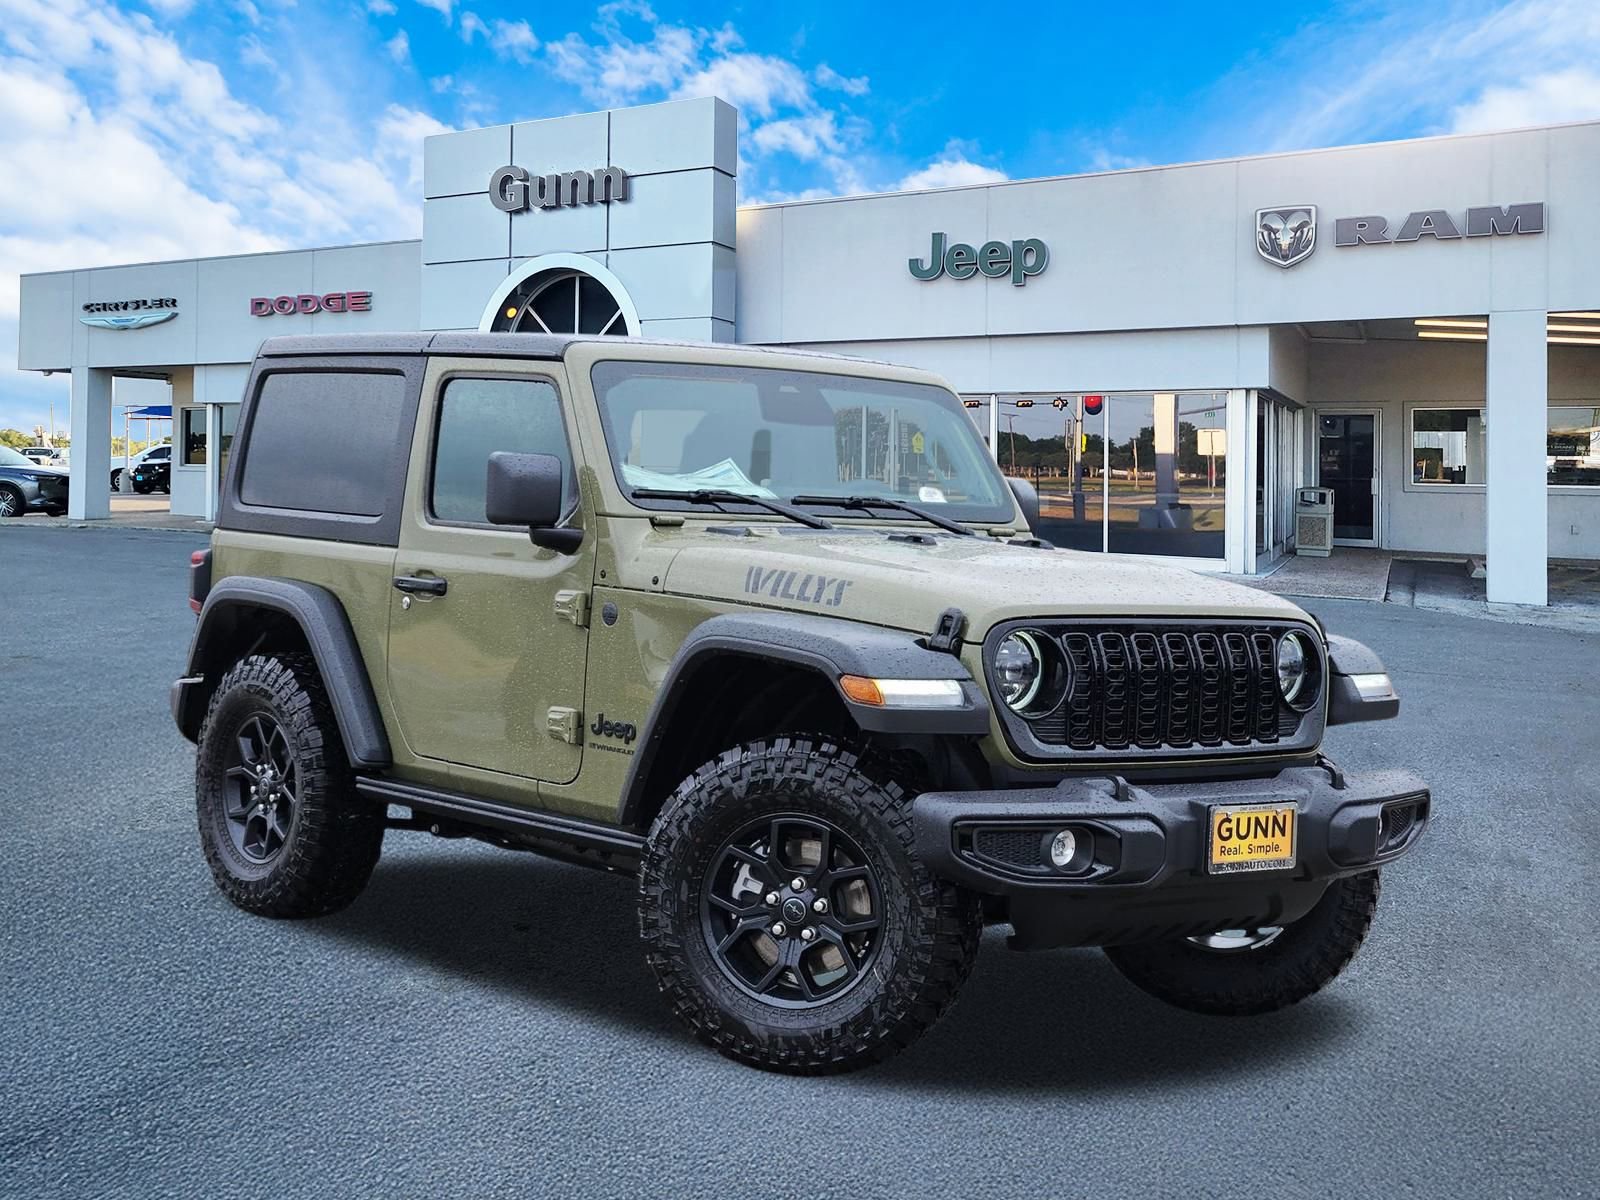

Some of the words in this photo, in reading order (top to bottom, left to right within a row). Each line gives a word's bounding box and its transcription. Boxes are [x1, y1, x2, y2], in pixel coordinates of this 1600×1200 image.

[489, 164, 628, 212] Gunn
[1334, 201, 1546, 248] RAM
[908, 231, 1051, 287] Jeep
[82, 297, 178, 313] CHRYSLER
[250, 291, 373, 317] DODGE
[744, 565, 855, 607] WILLYS
[590, 712, 637, 745] Jeep
[1217, 814, 1287, 842] GUNN
[1220, 844, 1244, 857] Real.
[1247, 841, 1283, 855] Simple.
